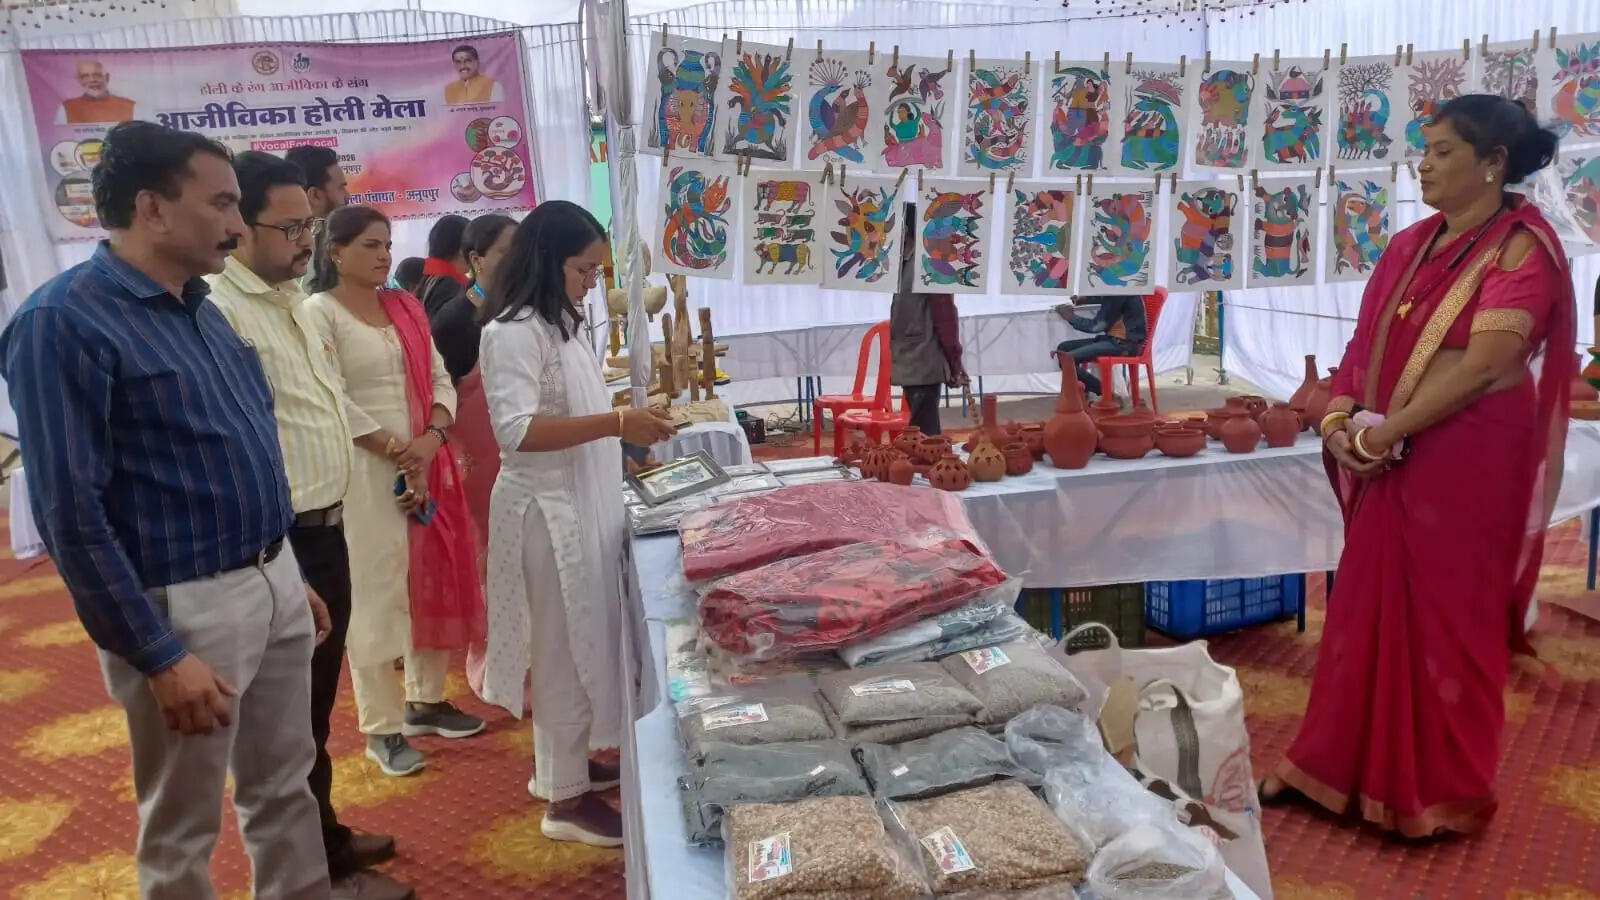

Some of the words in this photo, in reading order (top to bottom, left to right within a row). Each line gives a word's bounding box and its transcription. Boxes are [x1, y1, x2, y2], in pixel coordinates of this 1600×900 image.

[247, 80, 265, 94] रंग
[347, 76, 369, 89] संग
[156, 101, 297, 130] आजीविका
[301, 95, 366, 127] होली
[370, 94, 426, 119] मेला
[365, 191, 395, 203] पंचायत
